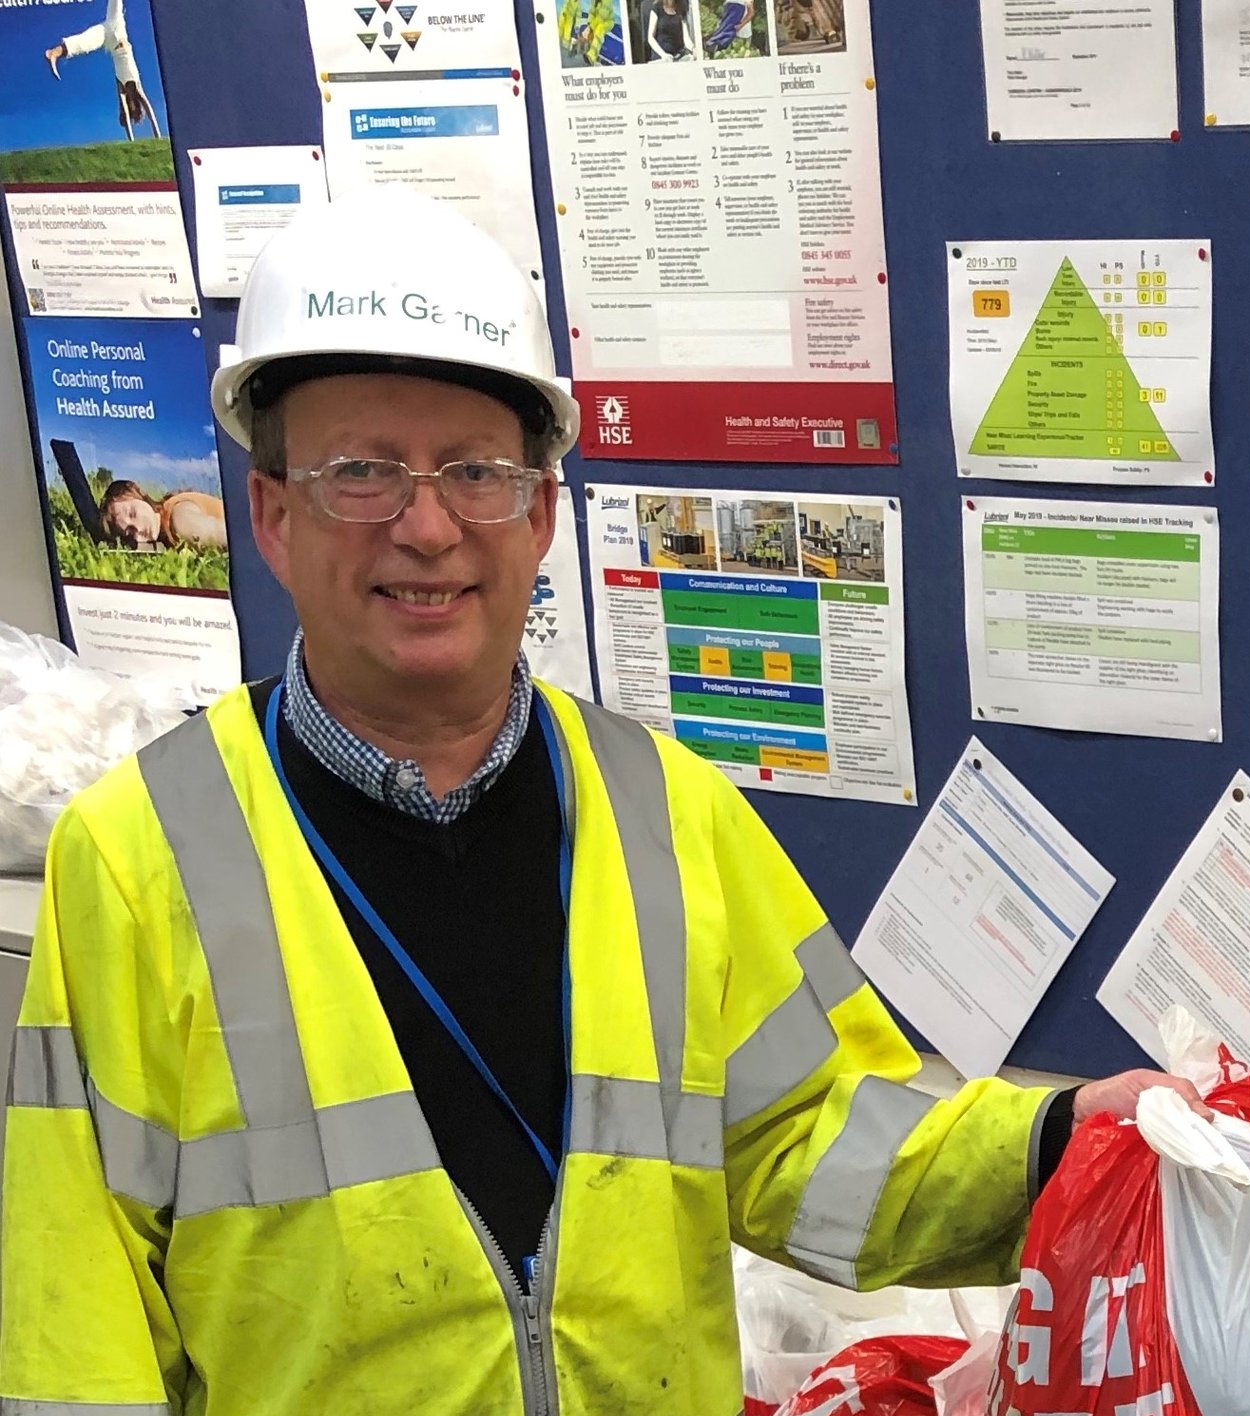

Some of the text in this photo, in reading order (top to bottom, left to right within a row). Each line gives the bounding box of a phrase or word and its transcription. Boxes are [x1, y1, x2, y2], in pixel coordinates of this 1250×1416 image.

[428, 15, 467, 25] BELOW THE
[703, 67, 744, 80] What you
[779, 63, 787, 75] If
[788, 62, 814, 75] there's
[561, 73, 624, 88] What employers
[706, 80, 740, 94] must do
[780, 77, 815, 93] problem
[565, 88, 627, 101] must do for you
[401, 117, 412, 126] the
[669, 180, 682, 189] 300
[11, 205, 41, 216] Powerful
[42, 205, 65, 216] Online
[67, 204, 92, 216] Health
[138, 204, 155, 215] with
[14, 220, 27, 232] tips
[29, 220, 41, 230] and
[966, 257, 1018, 269] 2019 YTD
[307, 290, 387, 319] Mark
[981, 298, 1002, 311] 779
[48, 340, 146, 361] Online Personal
[53, 368, 144, 394] Coaching from
[57, 397, 155, 420] Health Assured
[725, 416, 844, 431] Health and Safety Executive
[598, 426, 633, 445] HSE
[601, 496, 630, 508] Lubrizol
[1014, 511, 1026, 520] May
[1080, 514, 1094, 522] Near
[1165, 518, 1193, 528] Tracking
[607, 523, 628, 535] Bridge
[603, 536, 617, 545] Plan
[621, 573, 641, 585] Today
[688, 578, 788, 594] Communication and Culture
[842, 588, 867, 599] Future
[78, 606, 98, 617] Invest
[99, 609, 112, 621] just
[120, 611, 148, 622] minutes
[150, 614, 162, 625] and
[163, 616, 177, 628] you
[179, 616, 191, 627] will
[193, 617, 202, 628] be
[705, 634, 780, 649] Protecting our People
[703, 682, 791, 699] Protecting our Investment
[703, 727, 796, 746] Protecting our Environment
